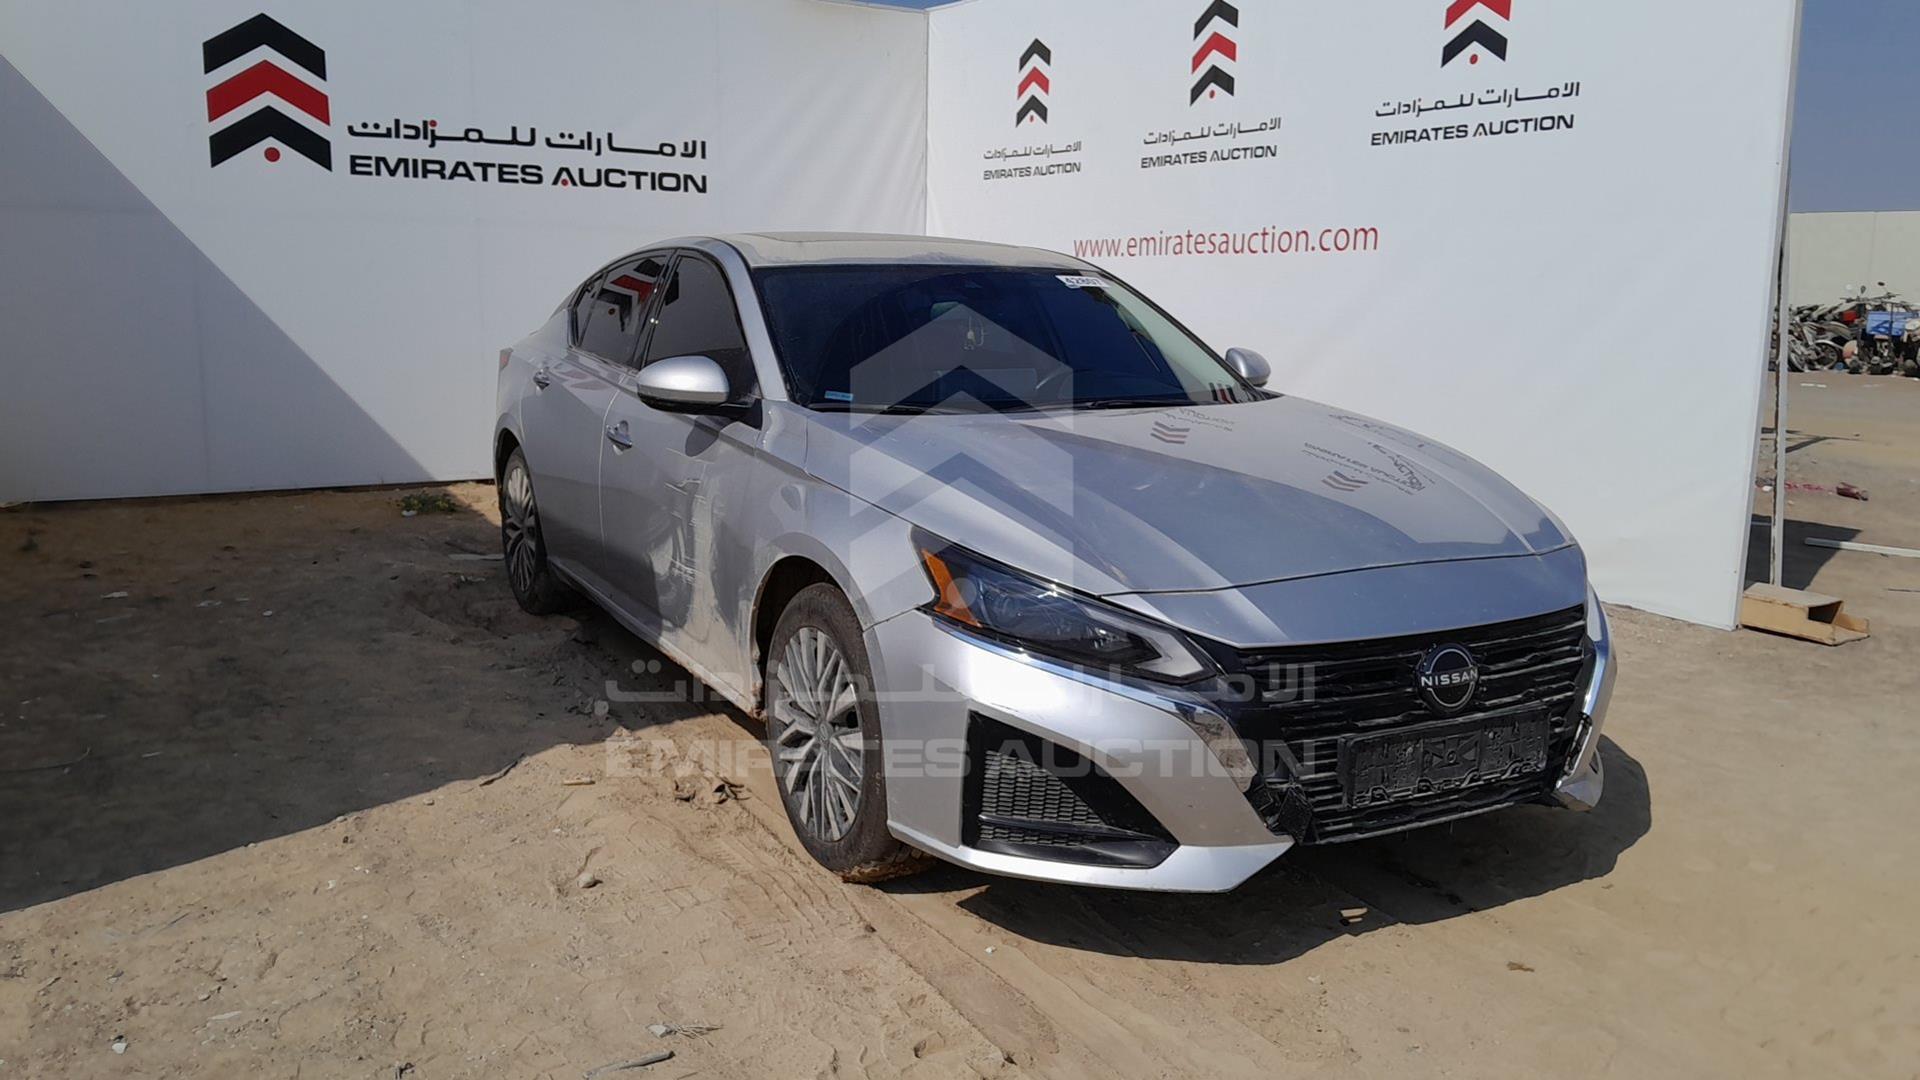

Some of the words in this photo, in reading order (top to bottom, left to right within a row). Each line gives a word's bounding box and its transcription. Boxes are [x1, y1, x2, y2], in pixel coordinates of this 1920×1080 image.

[1370, 124, 1468, 146] EMIRATES
[1472, 114, 1575, 138] AUCTION
[1140, 151, 1207, 169] EMIRATES
[1210, 145, 1278, 163] AUCTION
[349, 154, 544, 185] EMIRATES
[551, 166, 707, 194] AUCTION
[983, 166, 1032, 181] EMIRATES
[1033, 162, 1082, 177] AUCTION
[1073, 225, 1379, 258] www.emiratesauction.com
[1421, 668, 1478, 687] NISSAN
